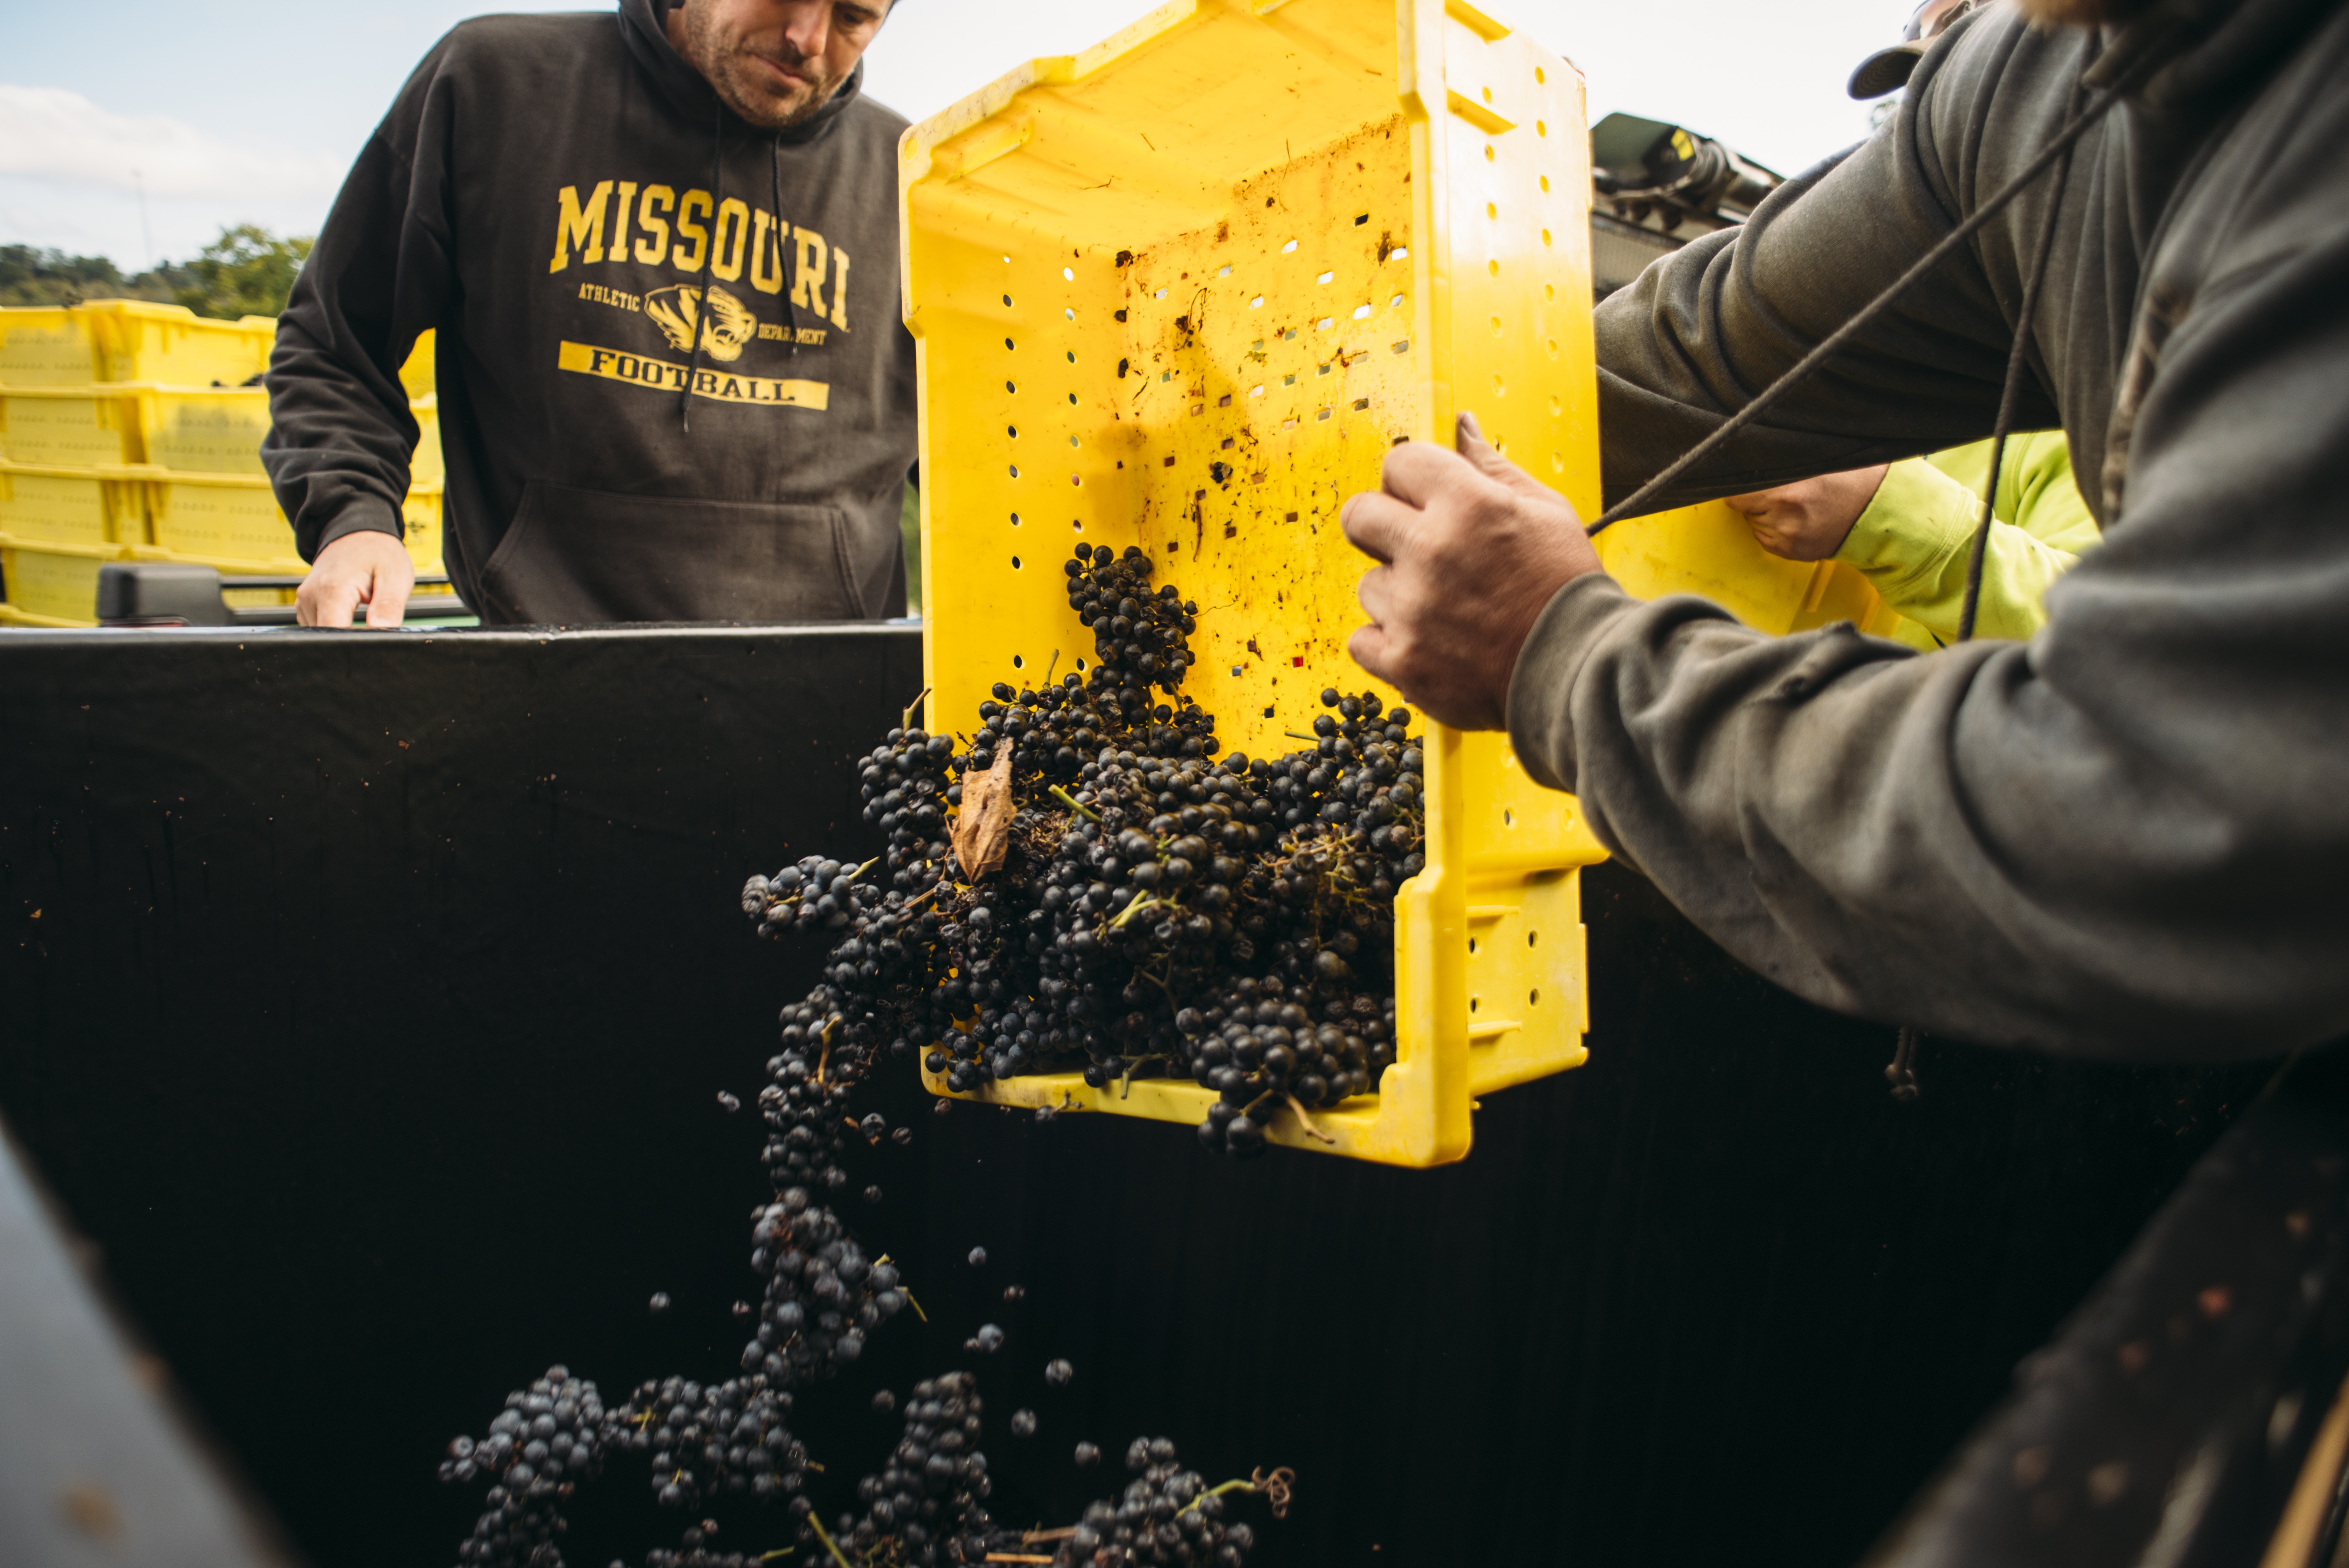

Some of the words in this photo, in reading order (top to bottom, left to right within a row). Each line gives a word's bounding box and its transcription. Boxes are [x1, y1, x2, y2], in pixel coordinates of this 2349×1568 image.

[550, 180, 850, 331] MISSOURI
[578, 282, 640, 312] ATHLETIC
[758, 323, 828, 346] DEPARMENT
[590, 349, 795, 401] FOOTBALL
